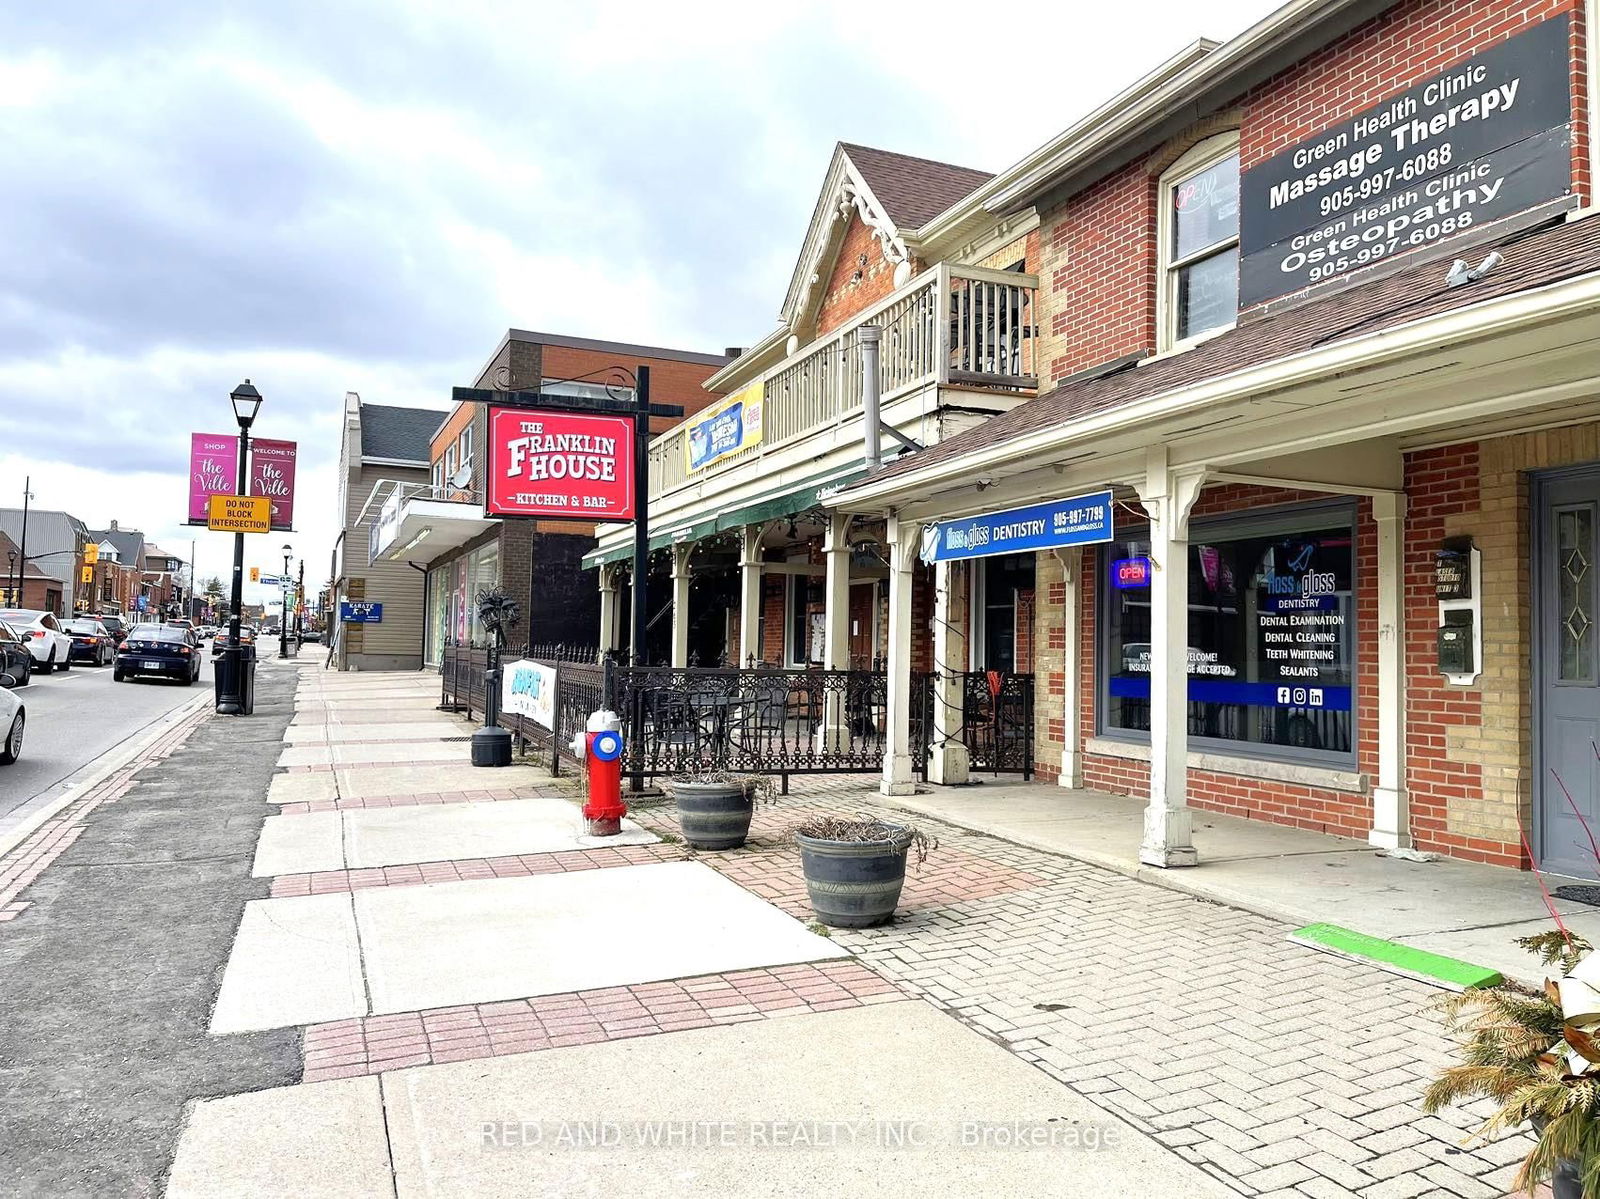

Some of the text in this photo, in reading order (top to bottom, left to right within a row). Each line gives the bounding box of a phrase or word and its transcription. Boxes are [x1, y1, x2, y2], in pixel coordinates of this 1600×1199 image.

[1293, 63, 1487, 169] Green Health Clinic
[1269, 78, 1520, 210] Massage Therapy
[1320, 143, 1453, 217] 905-997-6088
[1291, 162, 1491, 252] Green Health Clinic
[1280, 177, 1505, 272] Osteopathy
[1308, 211, 1473, 282] 905-997-6088
[520, 422, 543, 434] THE
[253, 448, 285, 456] WELCOME
[507, 433, 616, 477] FRANKLIN
[196, 459, 224, 474] the
[257, 463, 283, 479] the
[529, 455, 616, 482] HOUSE
[516, 493, 607, 508] KITCHEN & BAR
[227, 510, 252, 518] BLOCK
[1053, 505, 1104, 527] 905-997-7799
[211, 518, 267, 529] INTERSECTION
[967, 523, 989, 551] gloss
[993, 519, 1046, 541] DENTISTRY
[1119, 567, 1145, 579] OPEN
[1302, 568, 1335, 599] gloss
[1278, 599, 1320, 609] DENTISTRY
[1260, 615, 1344, 626] DENTAL EXAMINATION
[1265, 632, 1335, 643] DENTAL CLEANING
[1266, 648, 1334, 660] TEETH WHITENING
[1280, 665, 1319, 677] SEALANTS
